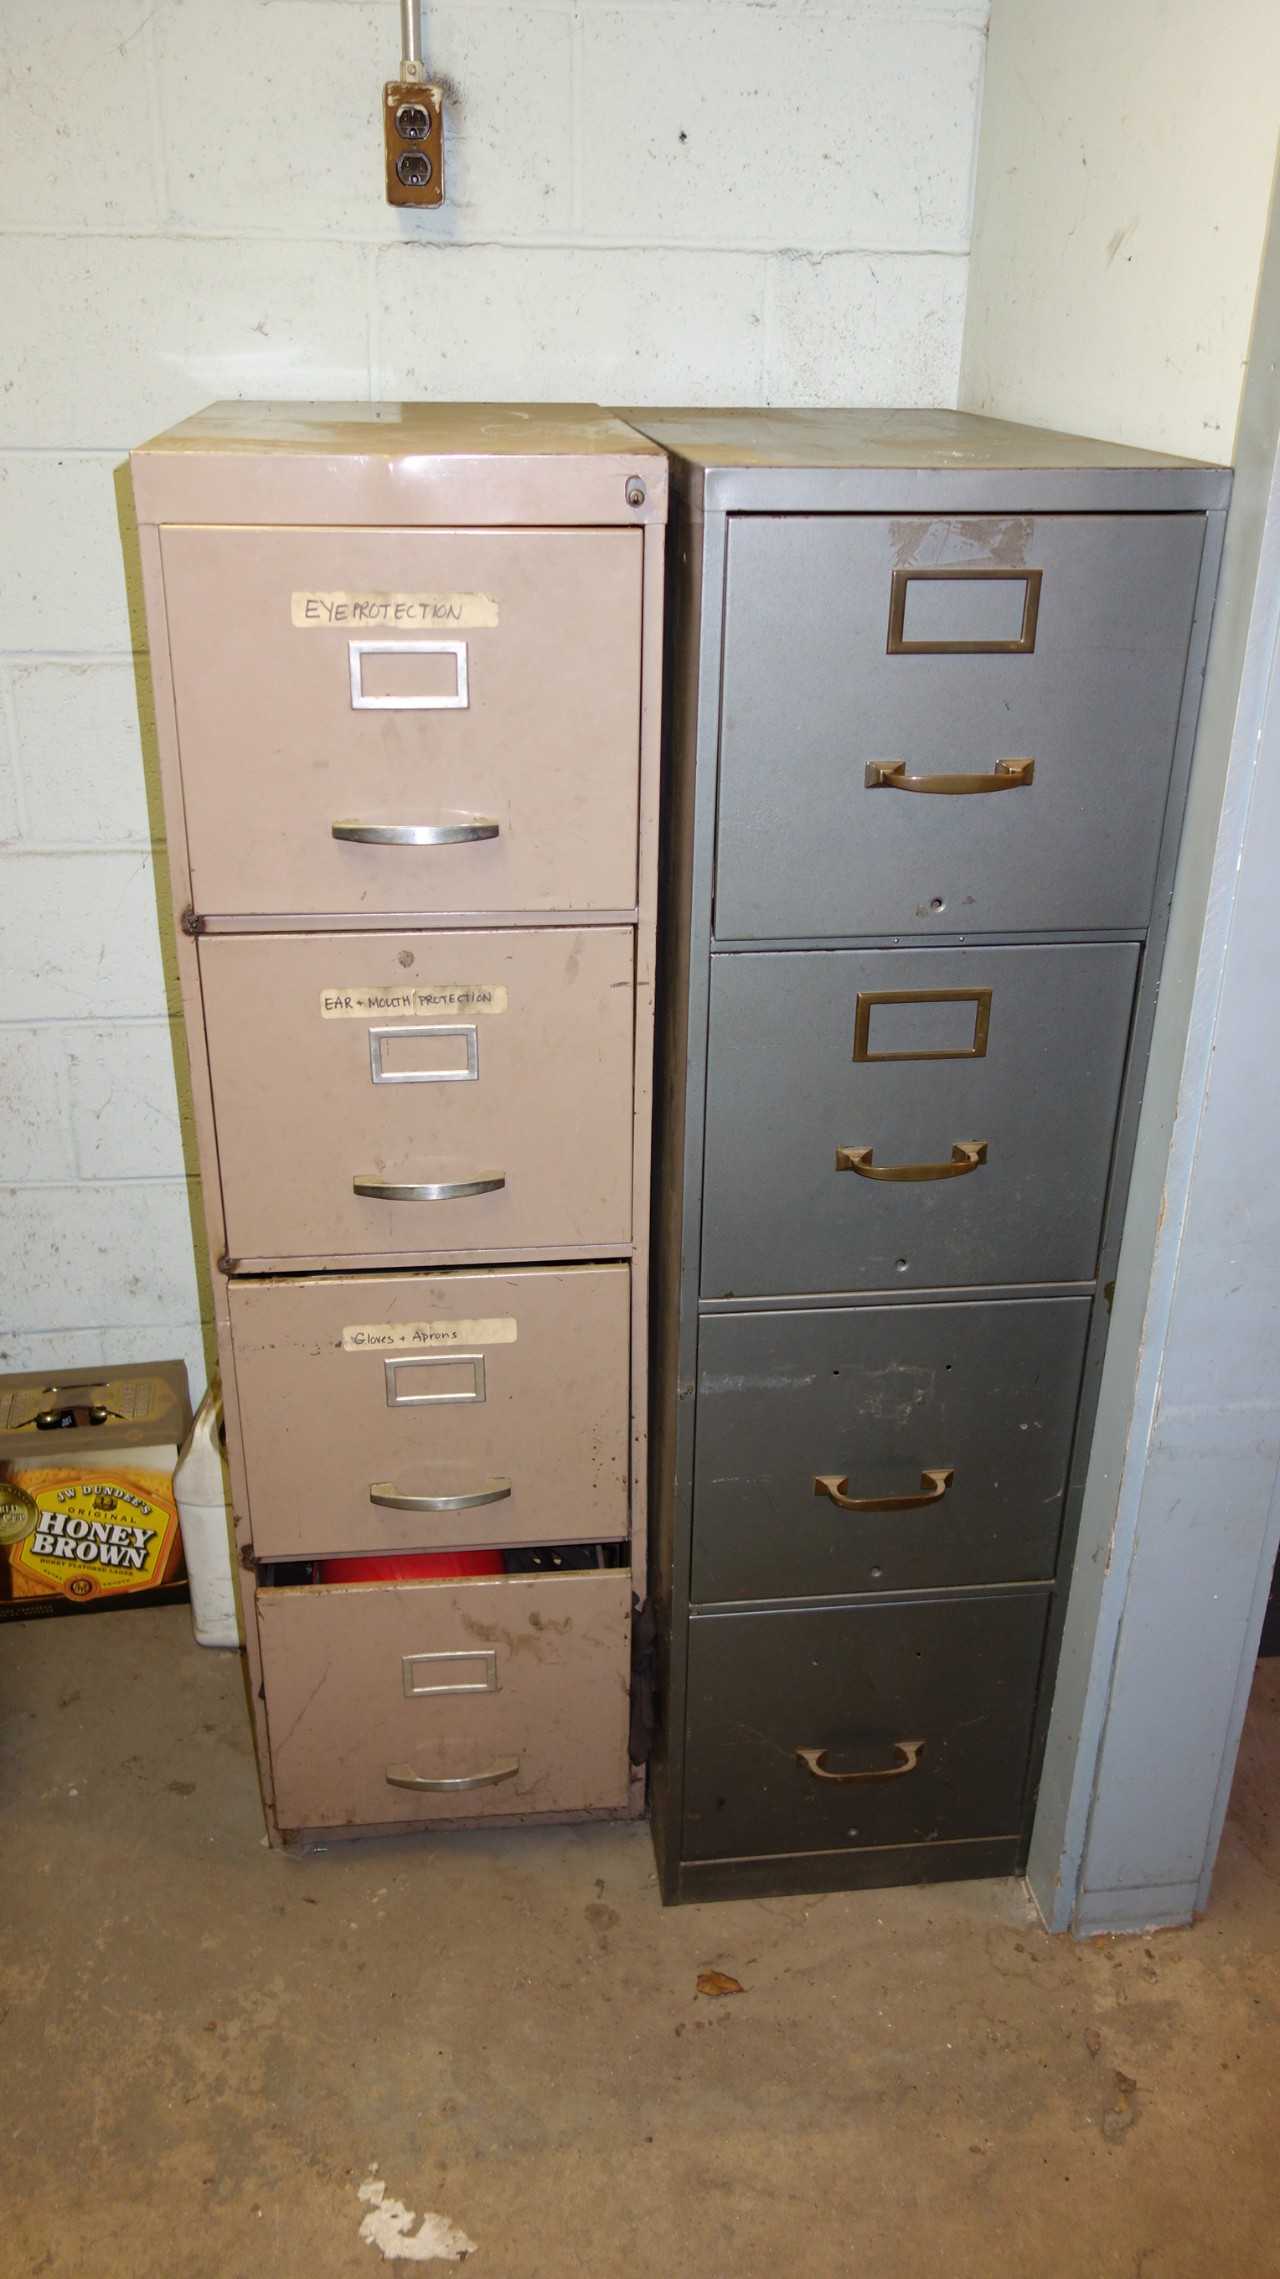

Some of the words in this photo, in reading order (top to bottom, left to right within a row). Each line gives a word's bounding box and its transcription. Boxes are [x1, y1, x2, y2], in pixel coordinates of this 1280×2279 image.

[324, 997, 353, 1010] EAR
[368, 994, 411, 1009] MOUTH
[417, 991, 493, 1007] PROTECTION
[353, 1332, 394, 1345] Gloves
[412, 1330, 458, 1343] Aprons
[57, 1487, 76, 1503] JW
[82, 1485, 152, 1515] DUNDEE'S
[67, 1506, 137, 1524] ORIGINAL
[37, 1511, 156, 1549] HONEY
[32, 1533, 148, 1569] BROWN
